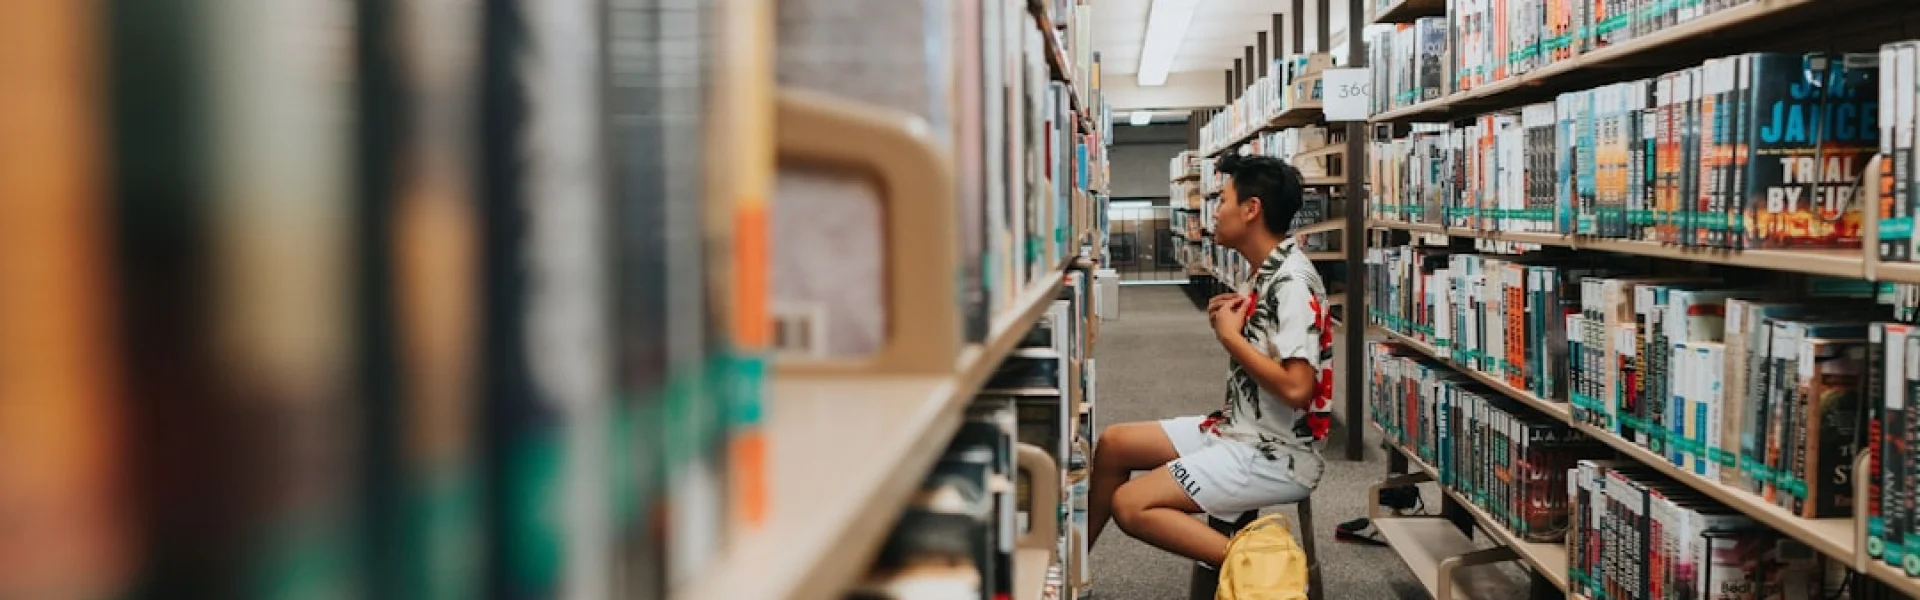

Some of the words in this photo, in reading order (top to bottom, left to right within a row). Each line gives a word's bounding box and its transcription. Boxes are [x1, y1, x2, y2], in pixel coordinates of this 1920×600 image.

[1761, 100, 1877, 144] JANCE
[1780, 157, 1857, 184] TRIAL
[1767, 186, 1802, 214] BY
